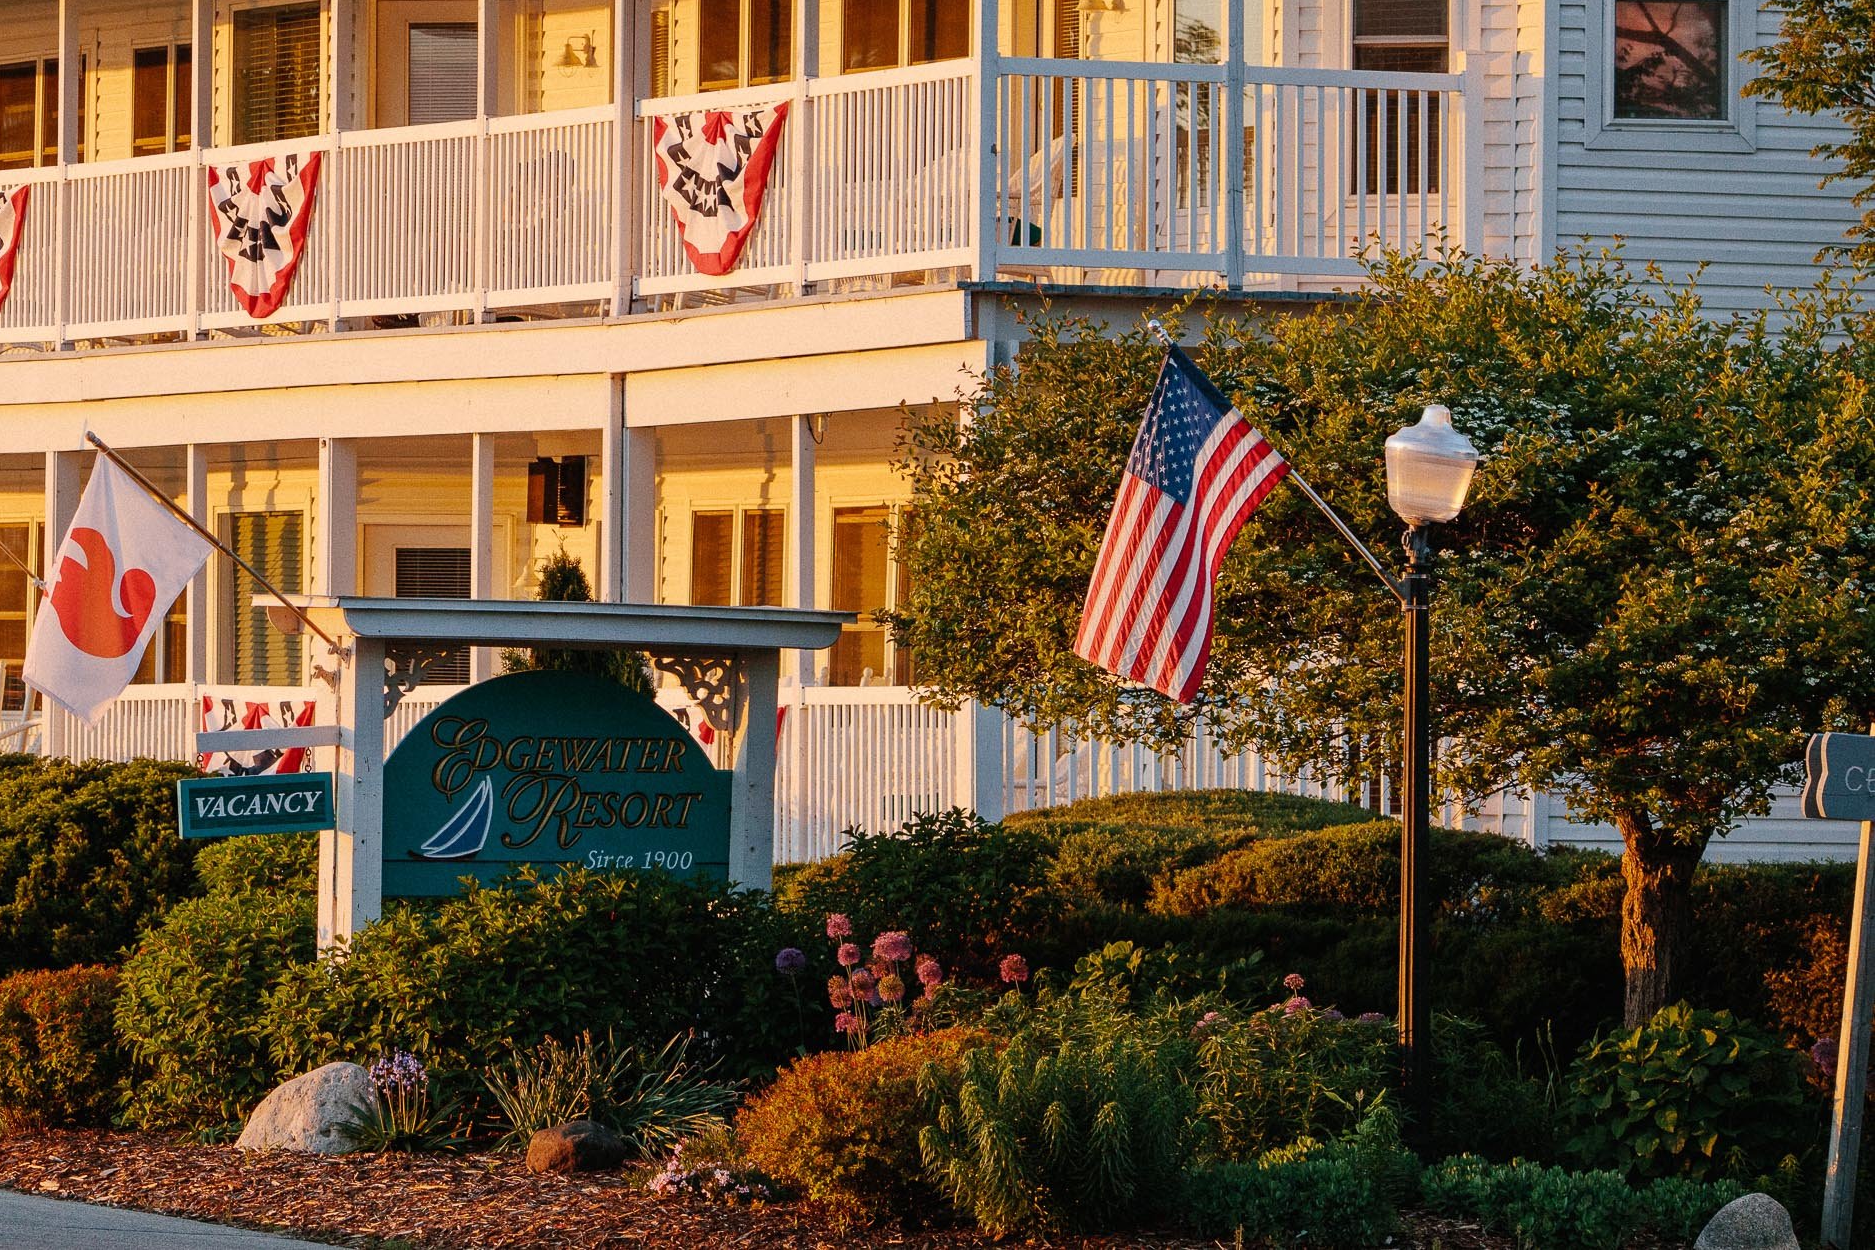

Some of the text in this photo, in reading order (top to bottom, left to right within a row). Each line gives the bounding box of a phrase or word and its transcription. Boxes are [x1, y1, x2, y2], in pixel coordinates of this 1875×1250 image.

[432, 716, 686, 803] EDGEWATER
[195, 790, 323, 818] VACANCY
[501, 772, 702, 849] RESORT
[641, 851, 693, 870] 1900
